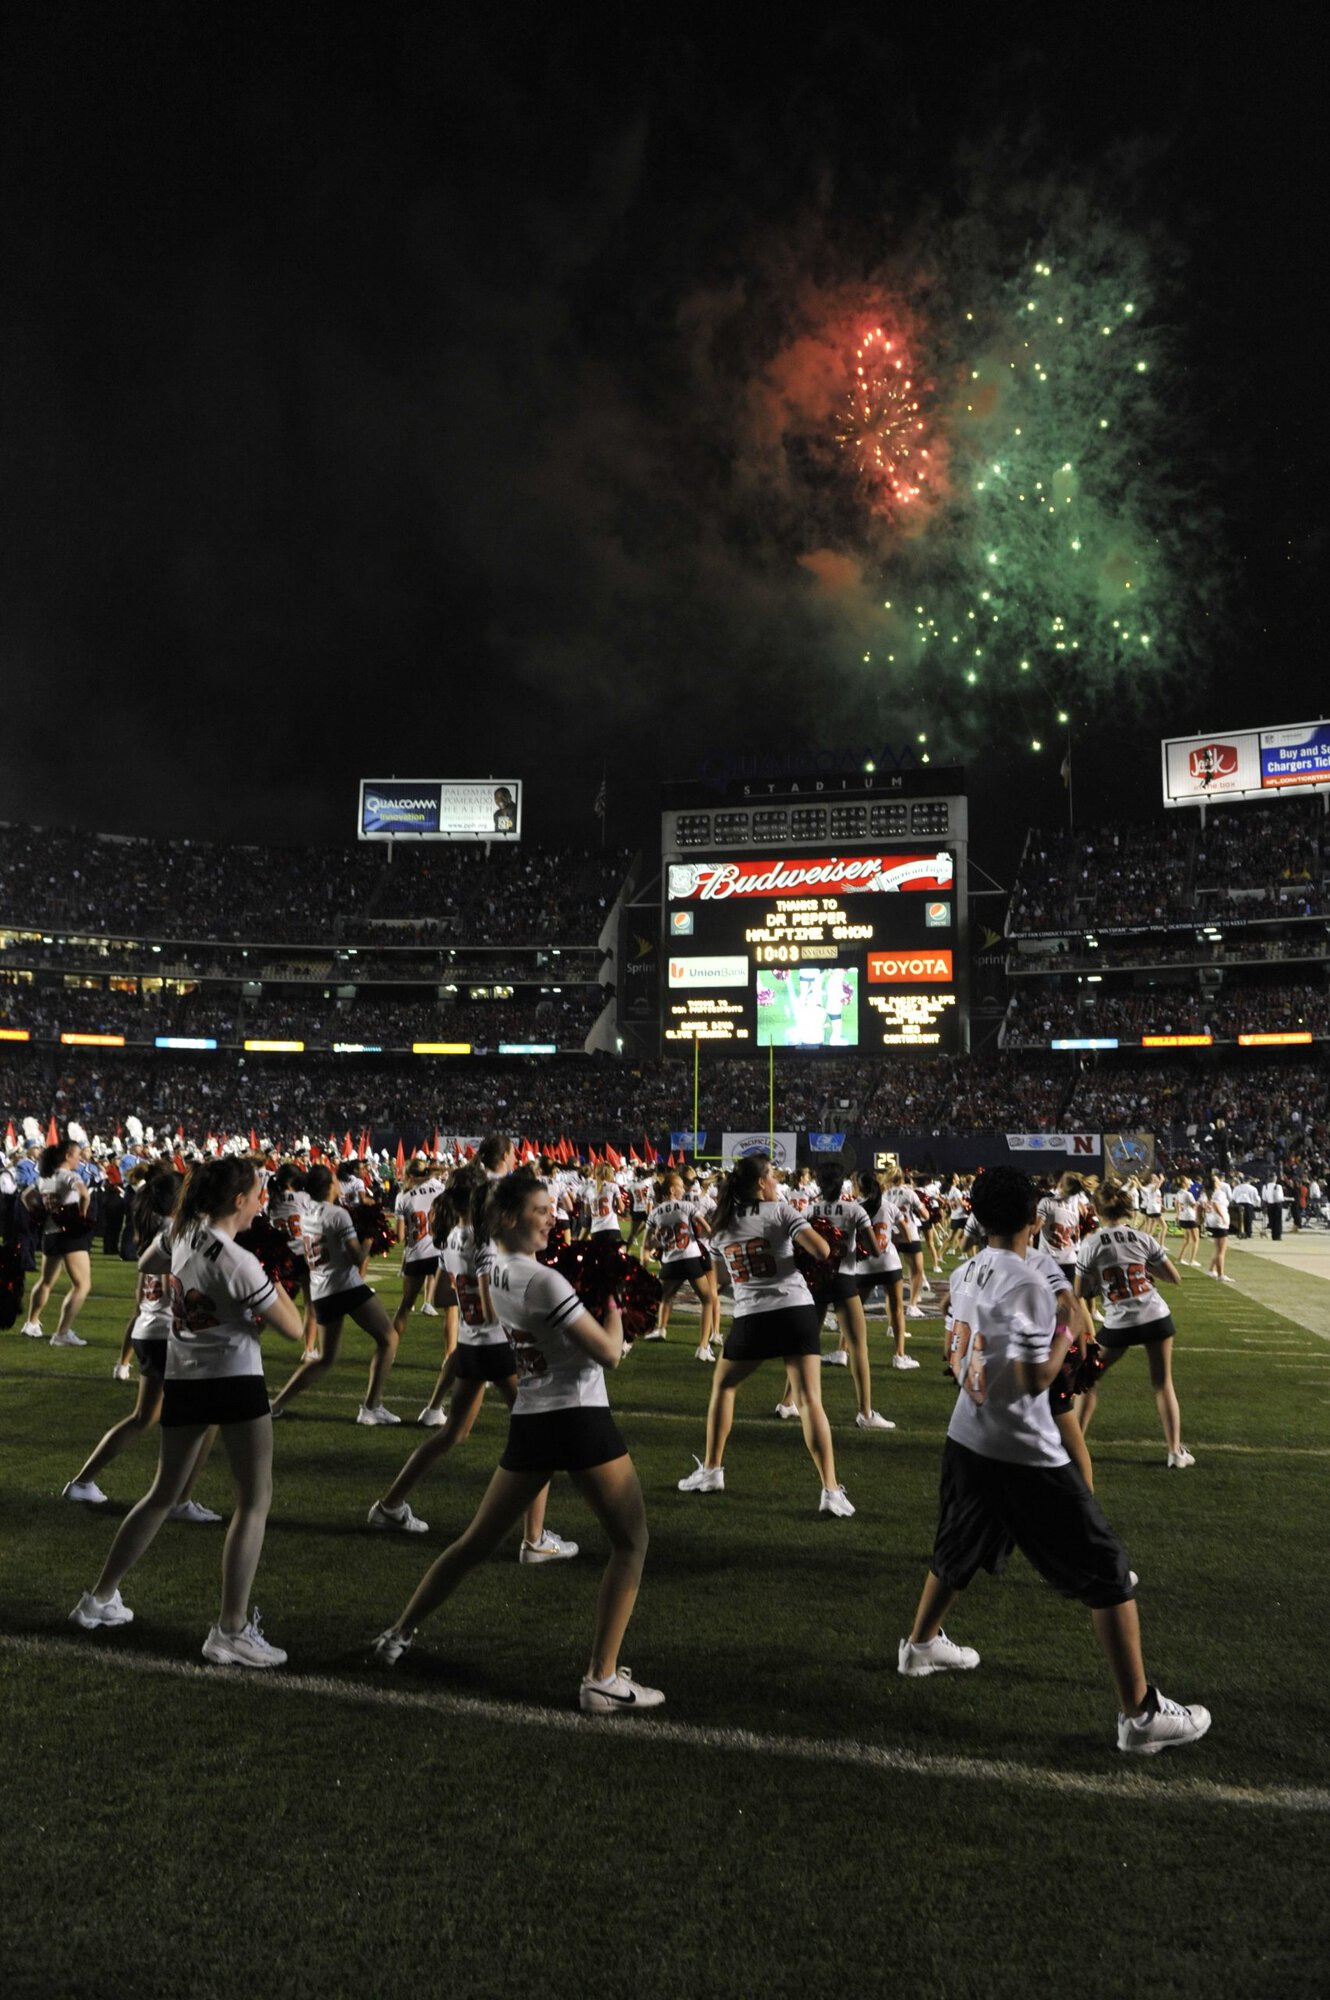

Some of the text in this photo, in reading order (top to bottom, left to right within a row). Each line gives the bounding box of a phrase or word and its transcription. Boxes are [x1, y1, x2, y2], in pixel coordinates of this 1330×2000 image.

[1280, 749, 1298, 760] Buy
[1300, 745, 1319, 757] and
[1267, 760, 1313, 773] Chargers
[444, 788, 493, 796] PALOMAR
[743, 776, 903, 796] STADIUM
[367, 797, 437, 814] QUALCOMM
[380, 813, 425, 821] Innovation
[695, 857, 882, 900] Budweiser
[776, 899, 838, 911] THANKS TO
[766, 911, 847, 926] DR PEPPER
[746, 925, 873, 941] HALFTIME SHOW
[871, 958, 949, 976] TOYOTA
[1178, 1035, 1211, 1046] FARGO
[1073, 1136, 1093, 1154] N
[877, 1153, 897, 1168] 25
[812, 1204, 843, 1217] BGA
[1100, 1230, 1138, 1246] BGA
[724, 1236, 778, 1284] 36
[1103, 1263, 1151, 1303] 36
